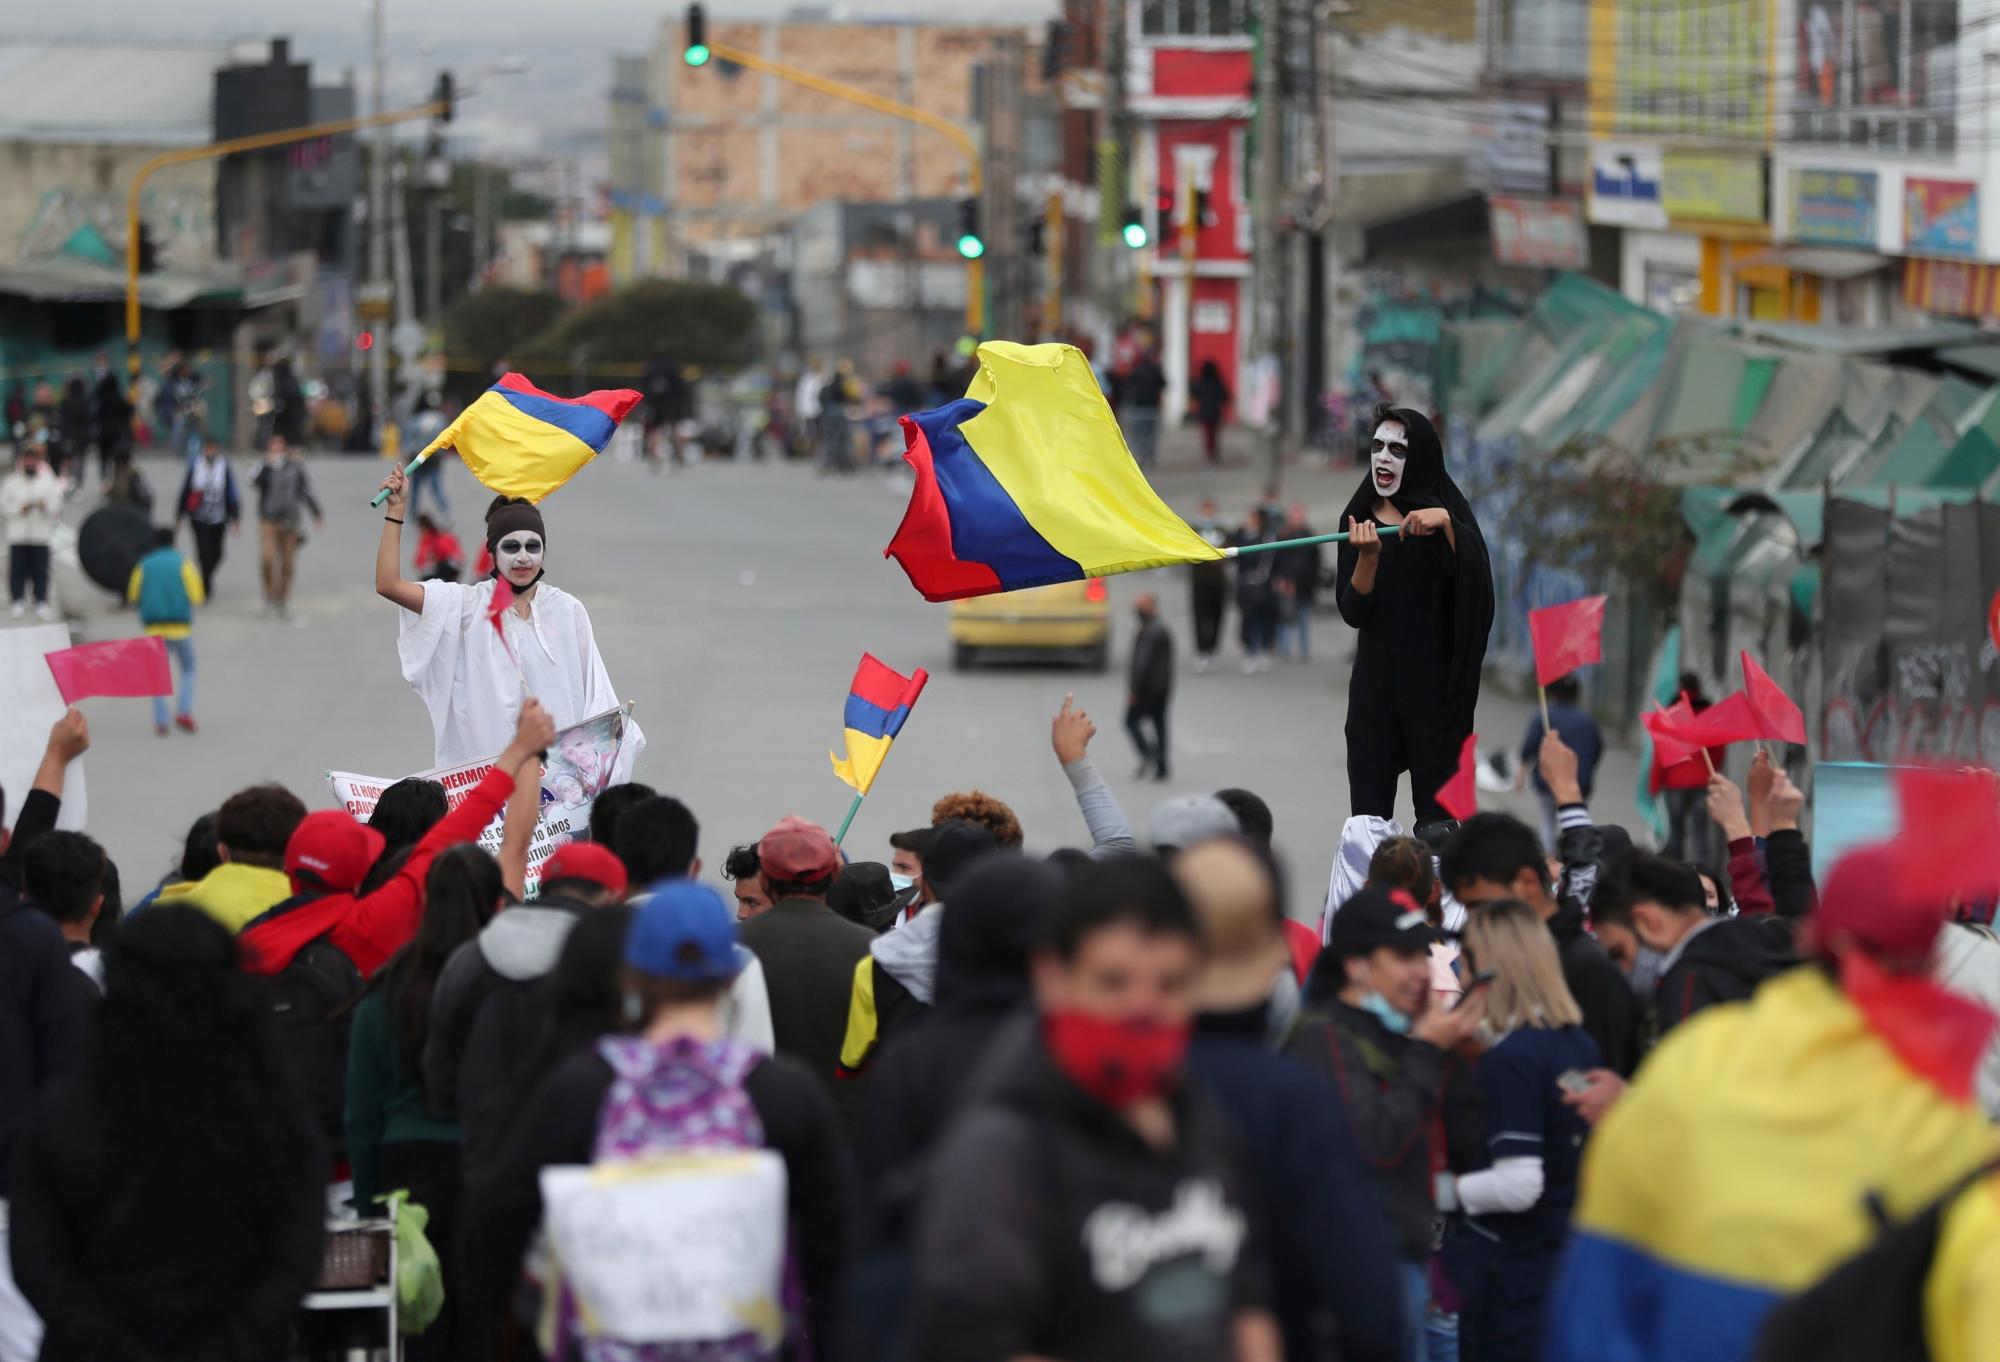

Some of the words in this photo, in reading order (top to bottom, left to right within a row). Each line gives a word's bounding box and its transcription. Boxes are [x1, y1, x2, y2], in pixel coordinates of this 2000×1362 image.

[441, 763, 497, 791] HERMOS
[360, 784, 386, 800] HOSP
[534, 829, 545, 842] 10
[546, 818, 571, 837] AÑOS
[526, 843, 555, 863] SITIVA
